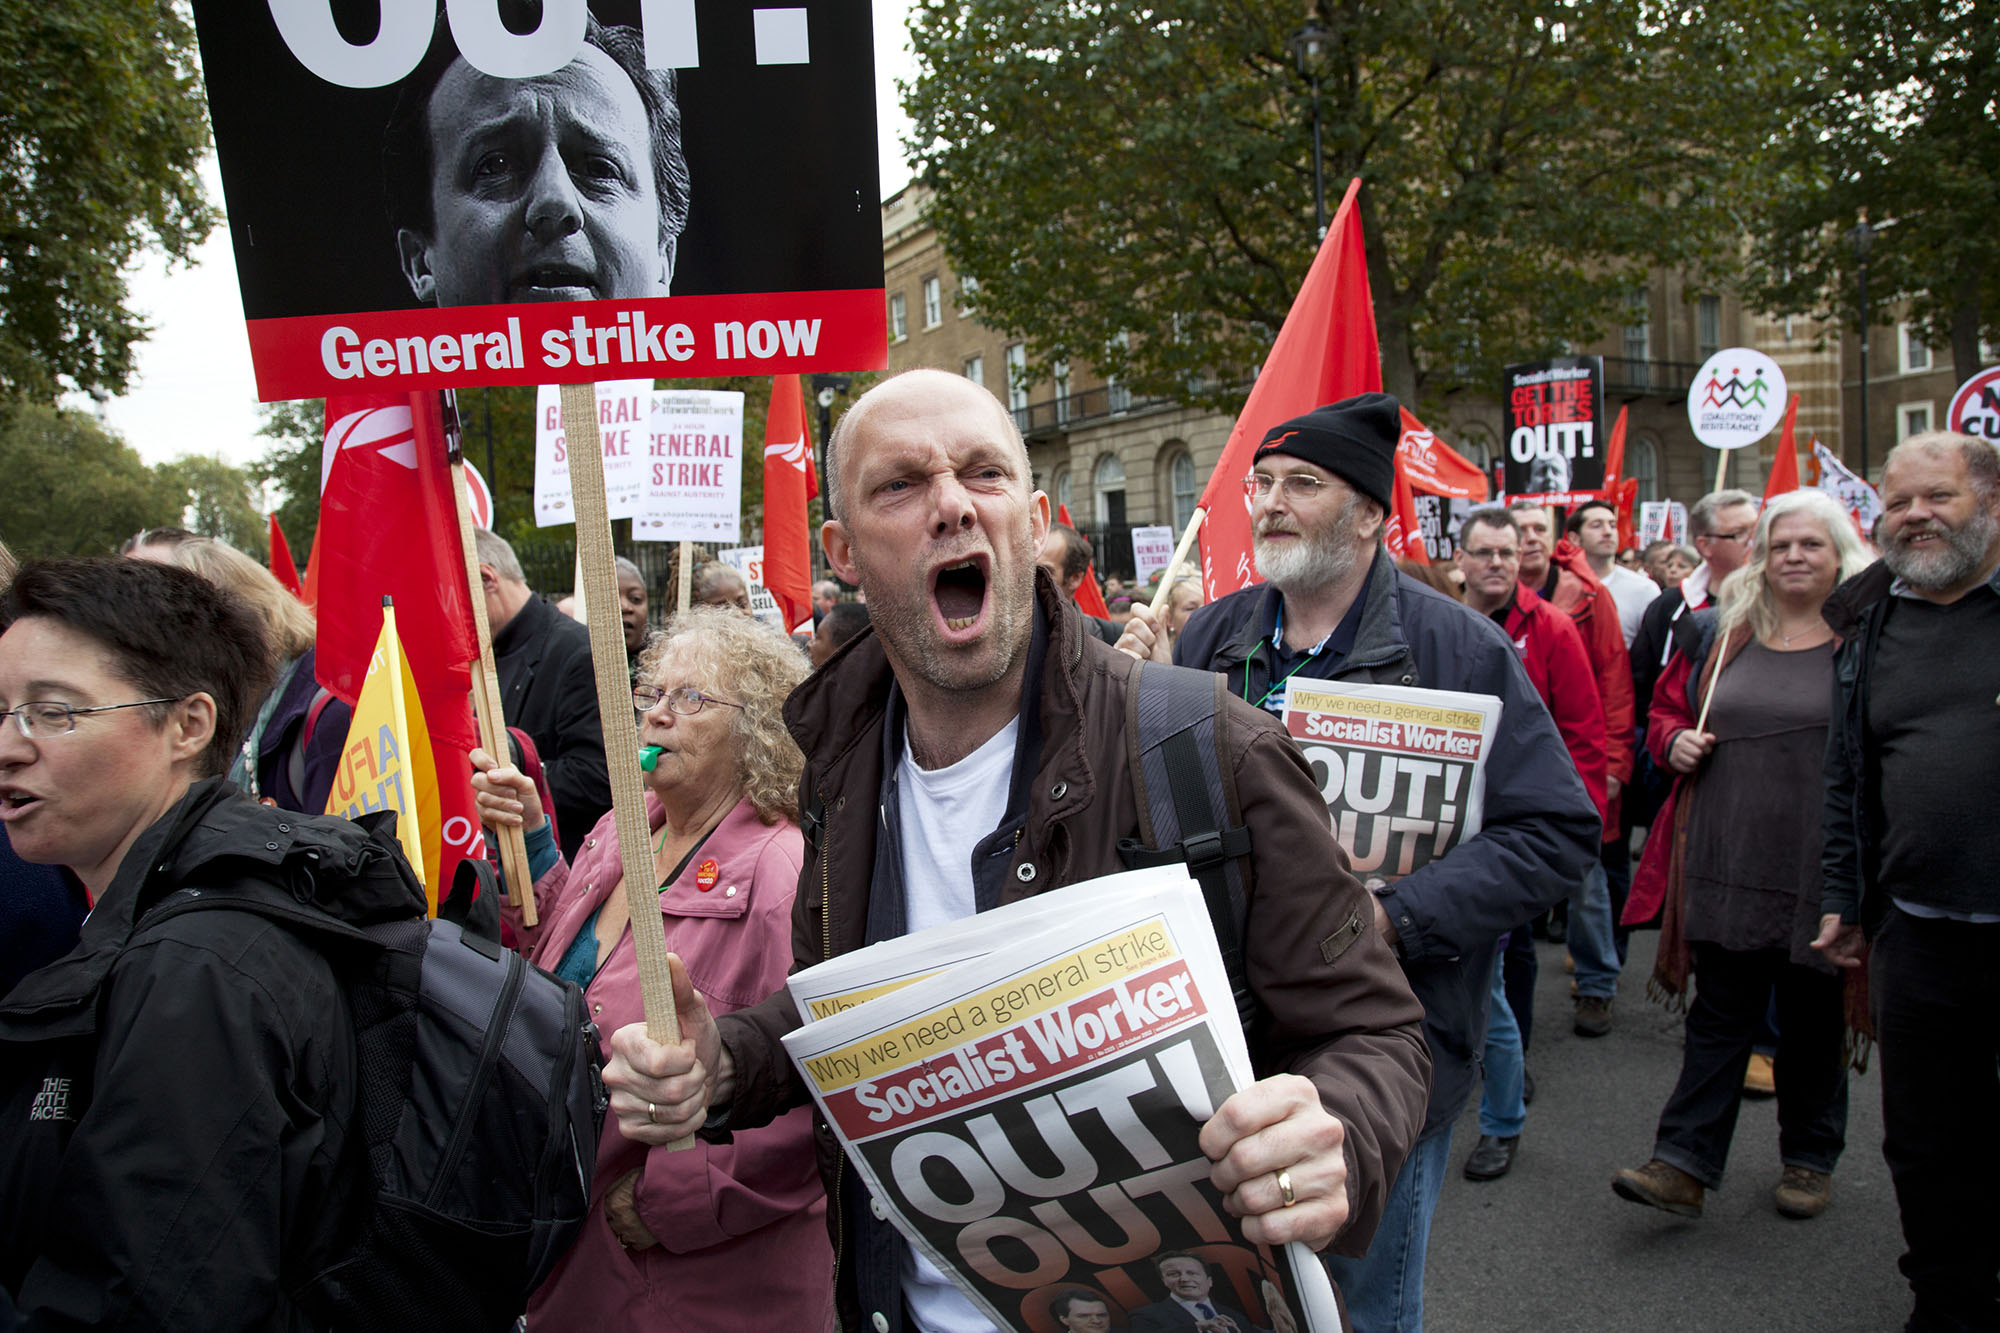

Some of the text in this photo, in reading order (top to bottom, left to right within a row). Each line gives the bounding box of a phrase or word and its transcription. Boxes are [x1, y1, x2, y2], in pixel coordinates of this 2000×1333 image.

[320, 310, 823, 380] General strike now
[1511, 379, 1593, 406] GET THE
[545, 396, 642, 431] GRAL
[1512, 400, 1593, 428] TORIES
[554, 429, 632, 462] SKE
[1510, 421, 1595, 464] OUT!
[652, 463, 724, 487] STRIKE
[1293, 691, 1480, 727] Why we need a general strike
[1305, 713, 1480, 756] Socialist Worker
[1300, 746, 1464, 822] OUT!
[1331, 810, 1455, 875] UT!
[807, 930, 1166, 1083] Why we need a general strike
[855, 971, 1191, 1123] Socialist Worker
[33, 1092, 68, 1107] RTH
[42, 1078, 72, 1092] THE
[30, 1106, 67, 1121] FACE
[890, 1039, 1214, 1223] OUT!
[956, 1156, 1233, 1290] OUT
